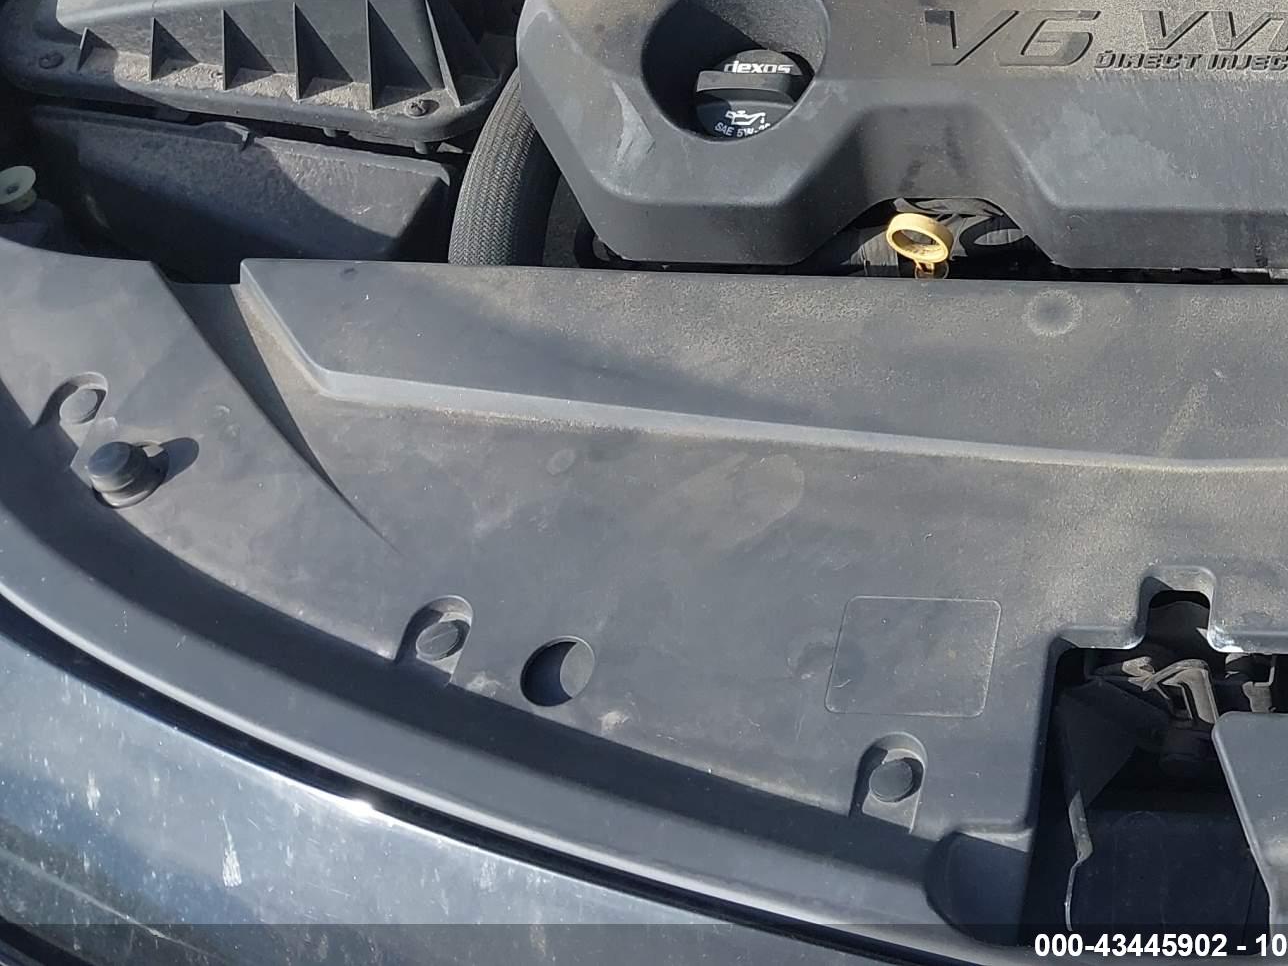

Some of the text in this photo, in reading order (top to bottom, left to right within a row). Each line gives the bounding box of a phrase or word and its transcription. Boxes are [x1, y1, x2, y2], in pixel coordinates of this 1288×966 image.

[925, 10, 1102, 66] V6
[723, 60, 794, 74] dexos
[1095, 52, 1202, 70] DIRECT
[714, 122, 735, 136] SAE
